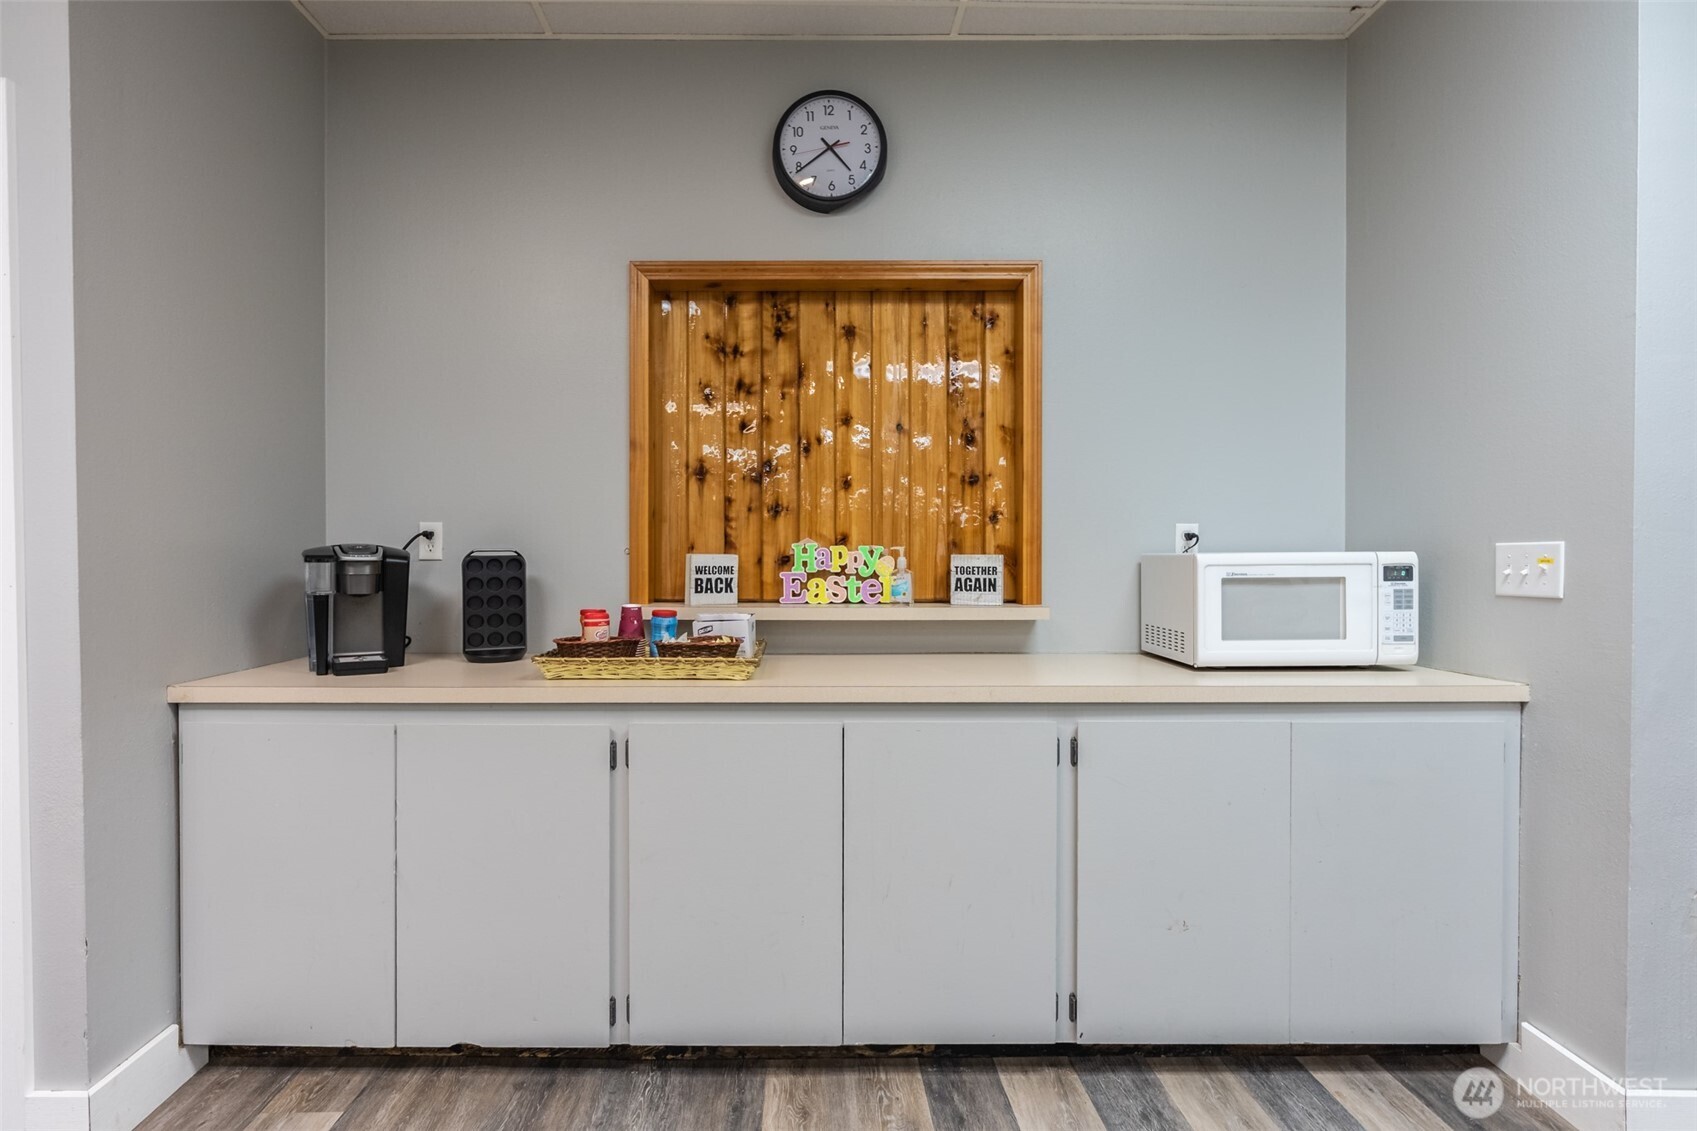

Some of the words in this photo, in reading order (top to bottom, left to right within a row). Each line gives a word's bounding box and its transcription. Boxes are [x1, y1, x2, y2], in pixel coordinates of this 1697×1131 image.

[823, 105, 835, 116] 12
[847, 110, 852, 120] 1
[805, 111, 815, 121] 11
[792, 127, 804, 137] 10
[860, 124, 868, 135] 2
[790, 145, 798, 156] 9
[864, 143, 872, 154] 3
[796, 162, 802, 172] 8
[860, 160, 866, 170] 4
[811, 176, 817, 186] 7
[848, 175, 856, 185] 5
[828, 180, 836, 191] 6
[791, 543, 884, 577] Happy
[694, 566, 735, 575] WELCOME
[954, 566, 998, 576] TOGETHER
[694, 577, 734, 594] BACK
[954, 577, 997, 592] AGAIN
